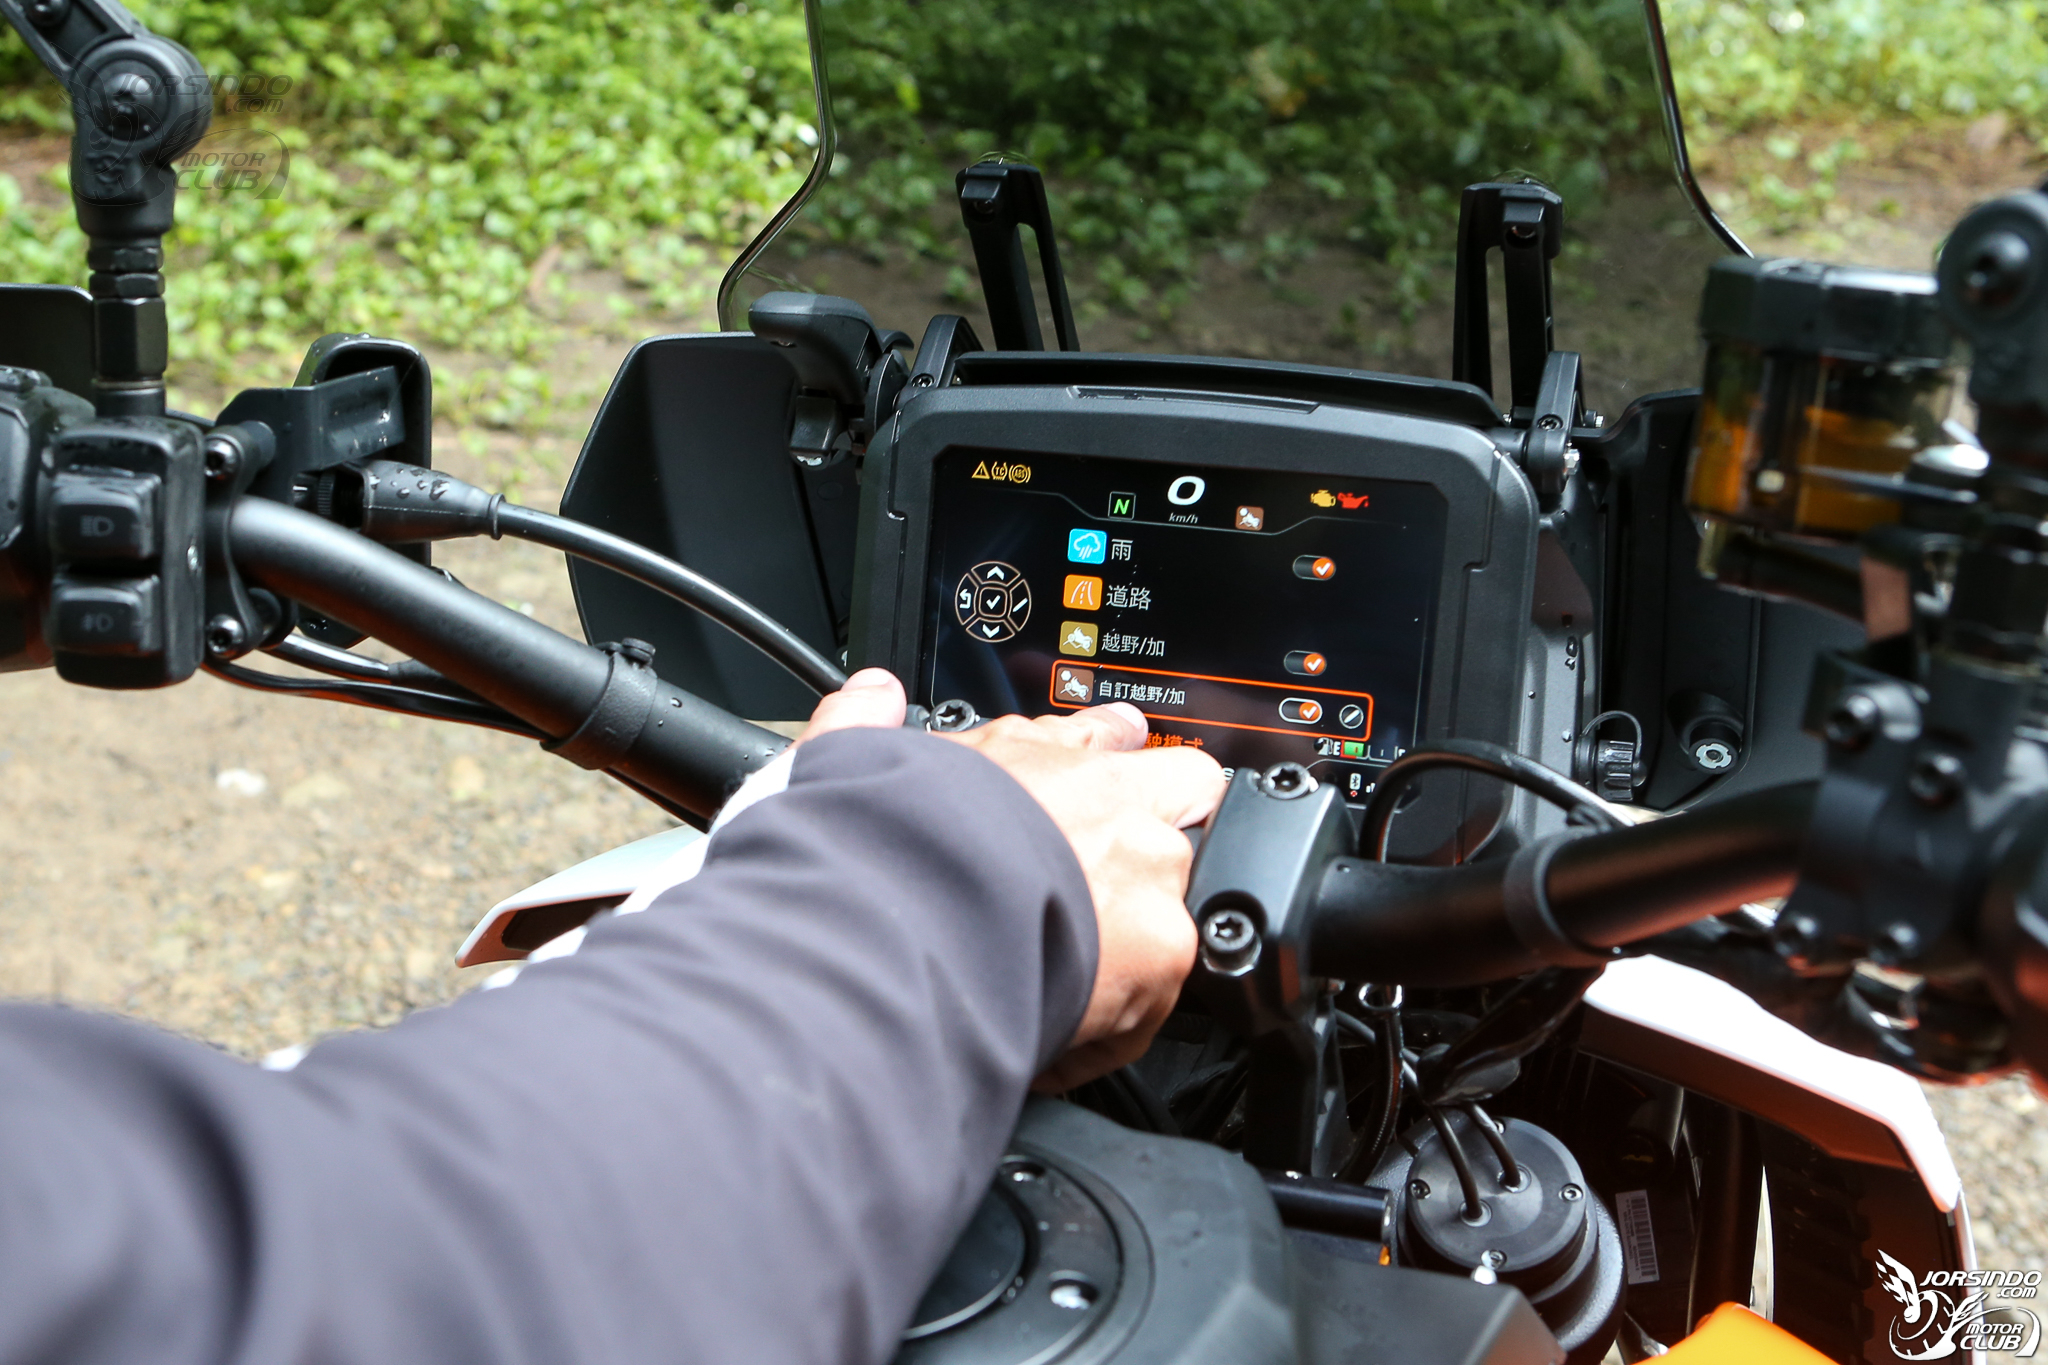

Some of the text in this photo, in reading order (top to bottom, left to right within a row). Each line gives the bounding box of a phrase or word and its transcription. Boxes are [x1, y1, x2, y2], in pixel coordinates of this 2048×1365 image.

[1167, 475, 1206, 505] 0
[1113, 498, 1130, 515] N
[1168, 512, 1199, 524] km/h
[1111, 538, 1134, 561] 雨
[1105, 584, 1152, 611] 道路
[1101, 632, 1166, 657] 越野/加
[1099, 680, 1186, 706] 自訂越野/加
[1333, 741, 1341, 756] E
